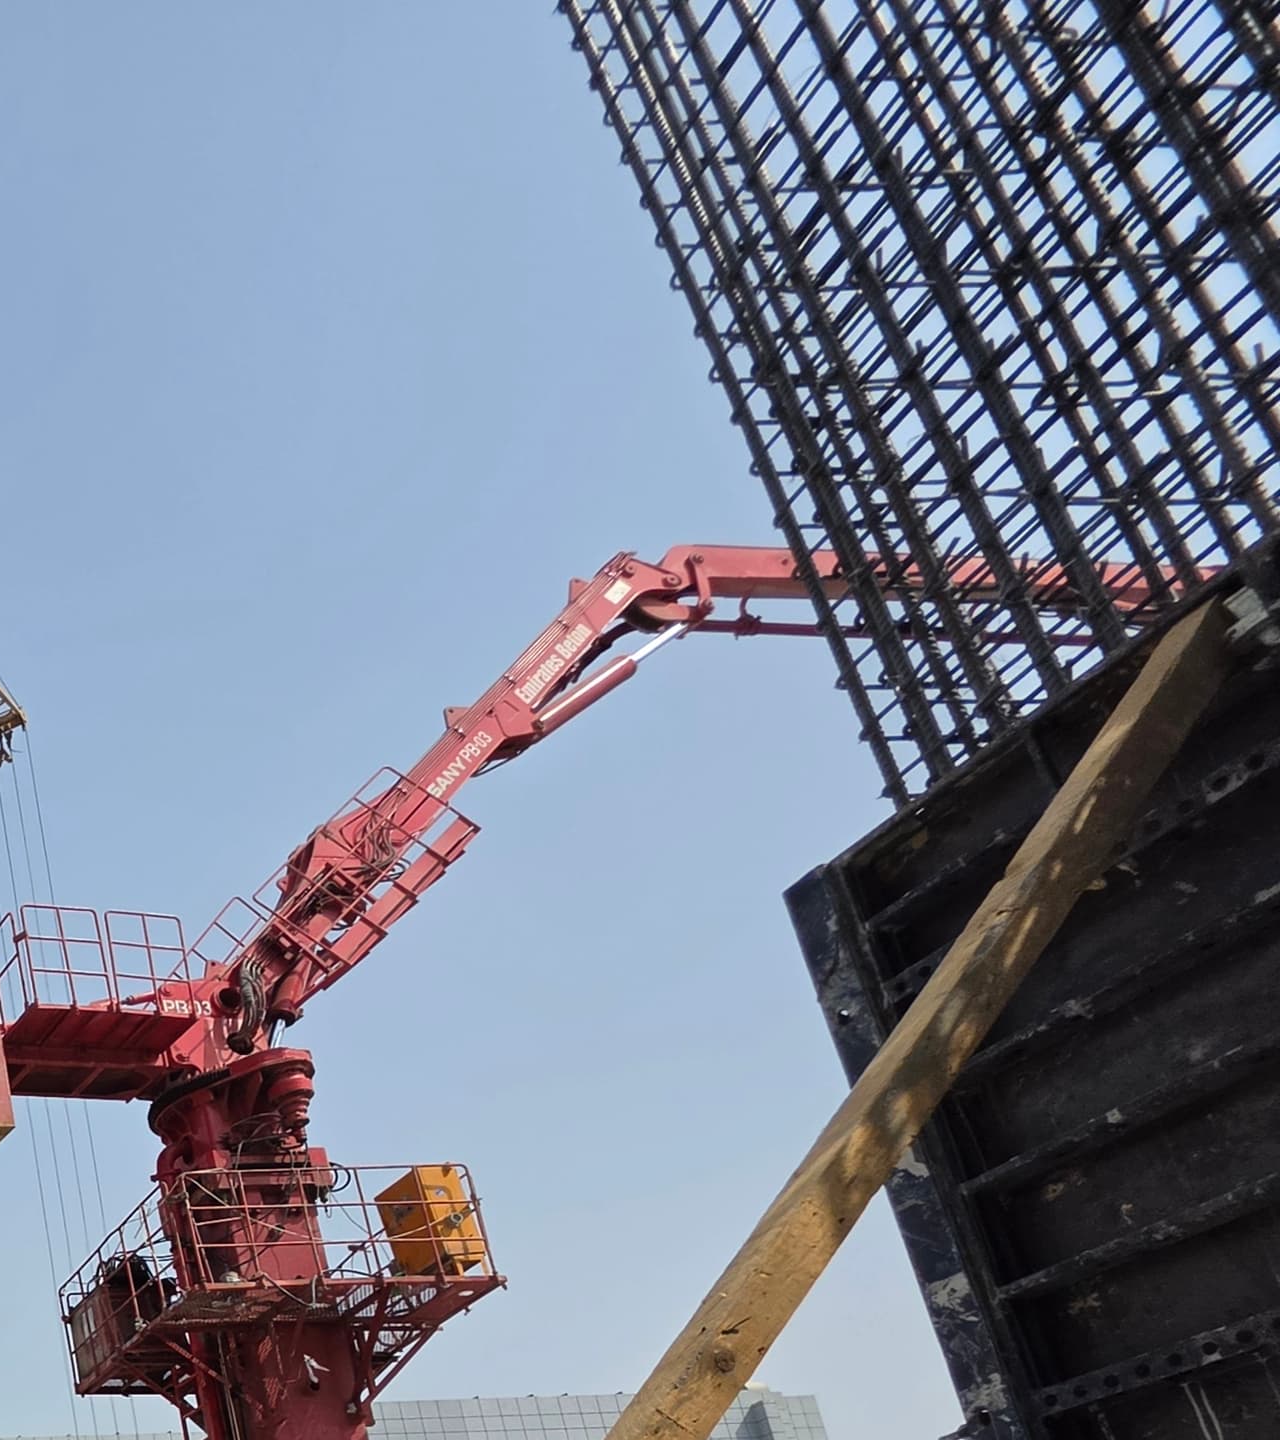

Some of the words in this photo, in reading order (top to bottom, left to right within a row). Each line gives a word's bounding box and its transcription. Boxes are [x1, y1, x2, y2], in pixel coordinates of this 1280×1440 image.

[513, 653, 565, 705] Emirates
[554, 623, 593, 661] Beton
[426, 756, 467, 799] SANY
[459, 731, 493, 764] PB-03
